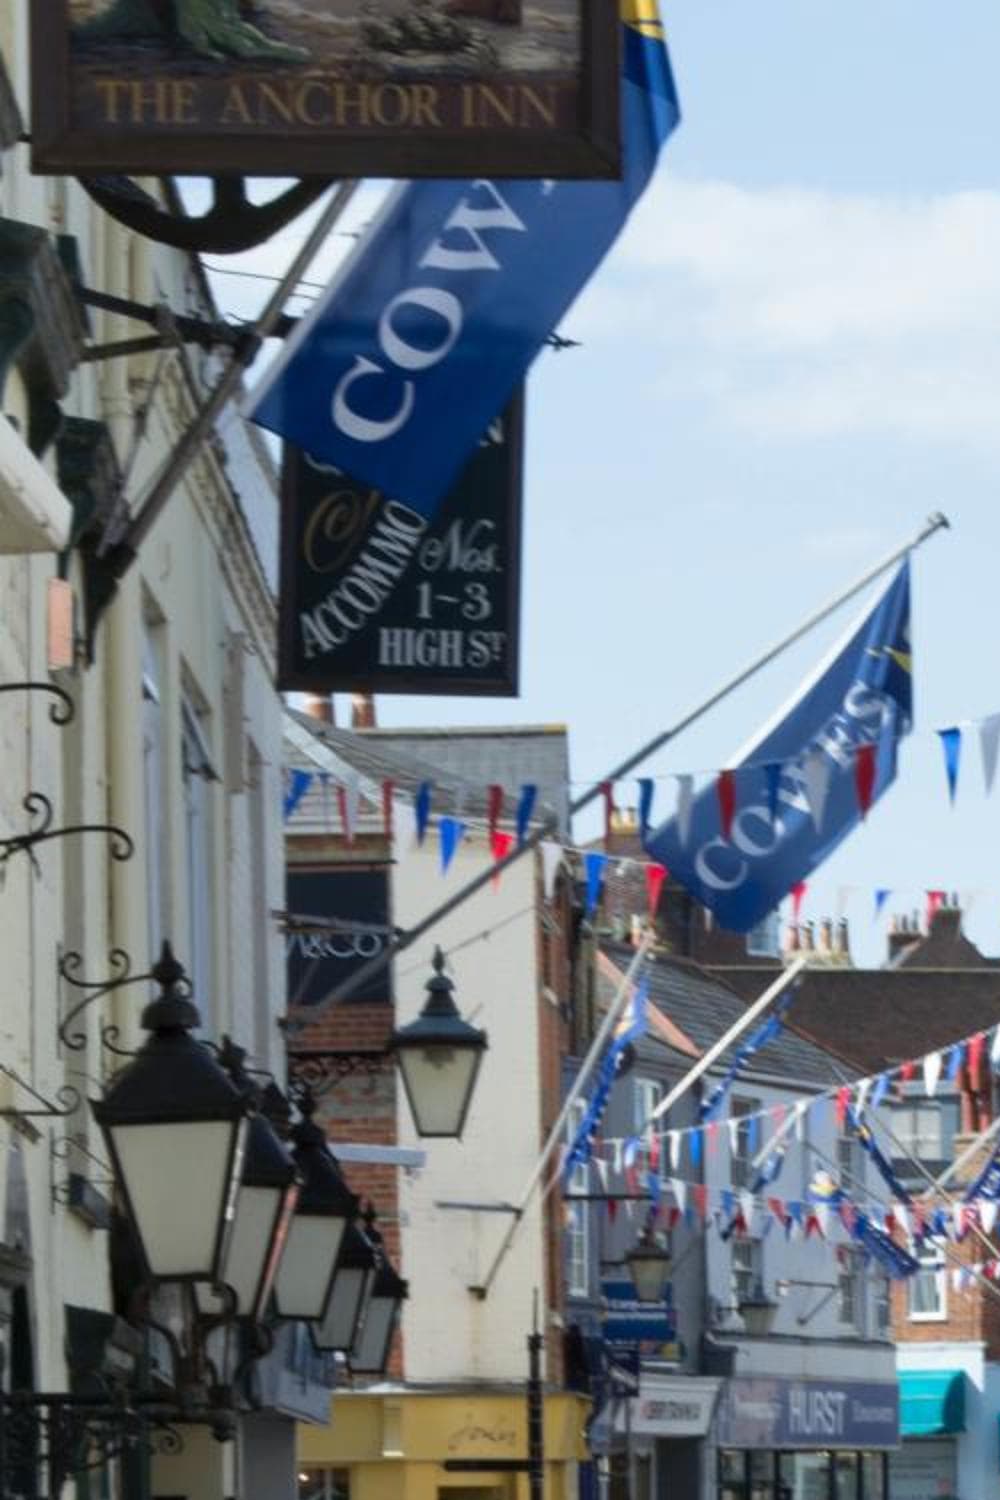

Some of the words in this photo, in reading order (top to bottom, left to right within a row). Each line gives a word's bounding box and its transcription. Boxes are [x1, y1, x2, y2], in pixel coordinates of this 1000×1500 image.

[96, 80, 198, 124] THE
[220, 81, 445, 128] ANCHOR
[463, 86, 560, 128] INN
[332, 178, 540, 442] COW
[300, 500, 428, 659] ACCOMMO
[378, 628, 464, 668] HIGH
[788, 1389, 847, 1436] HURST
